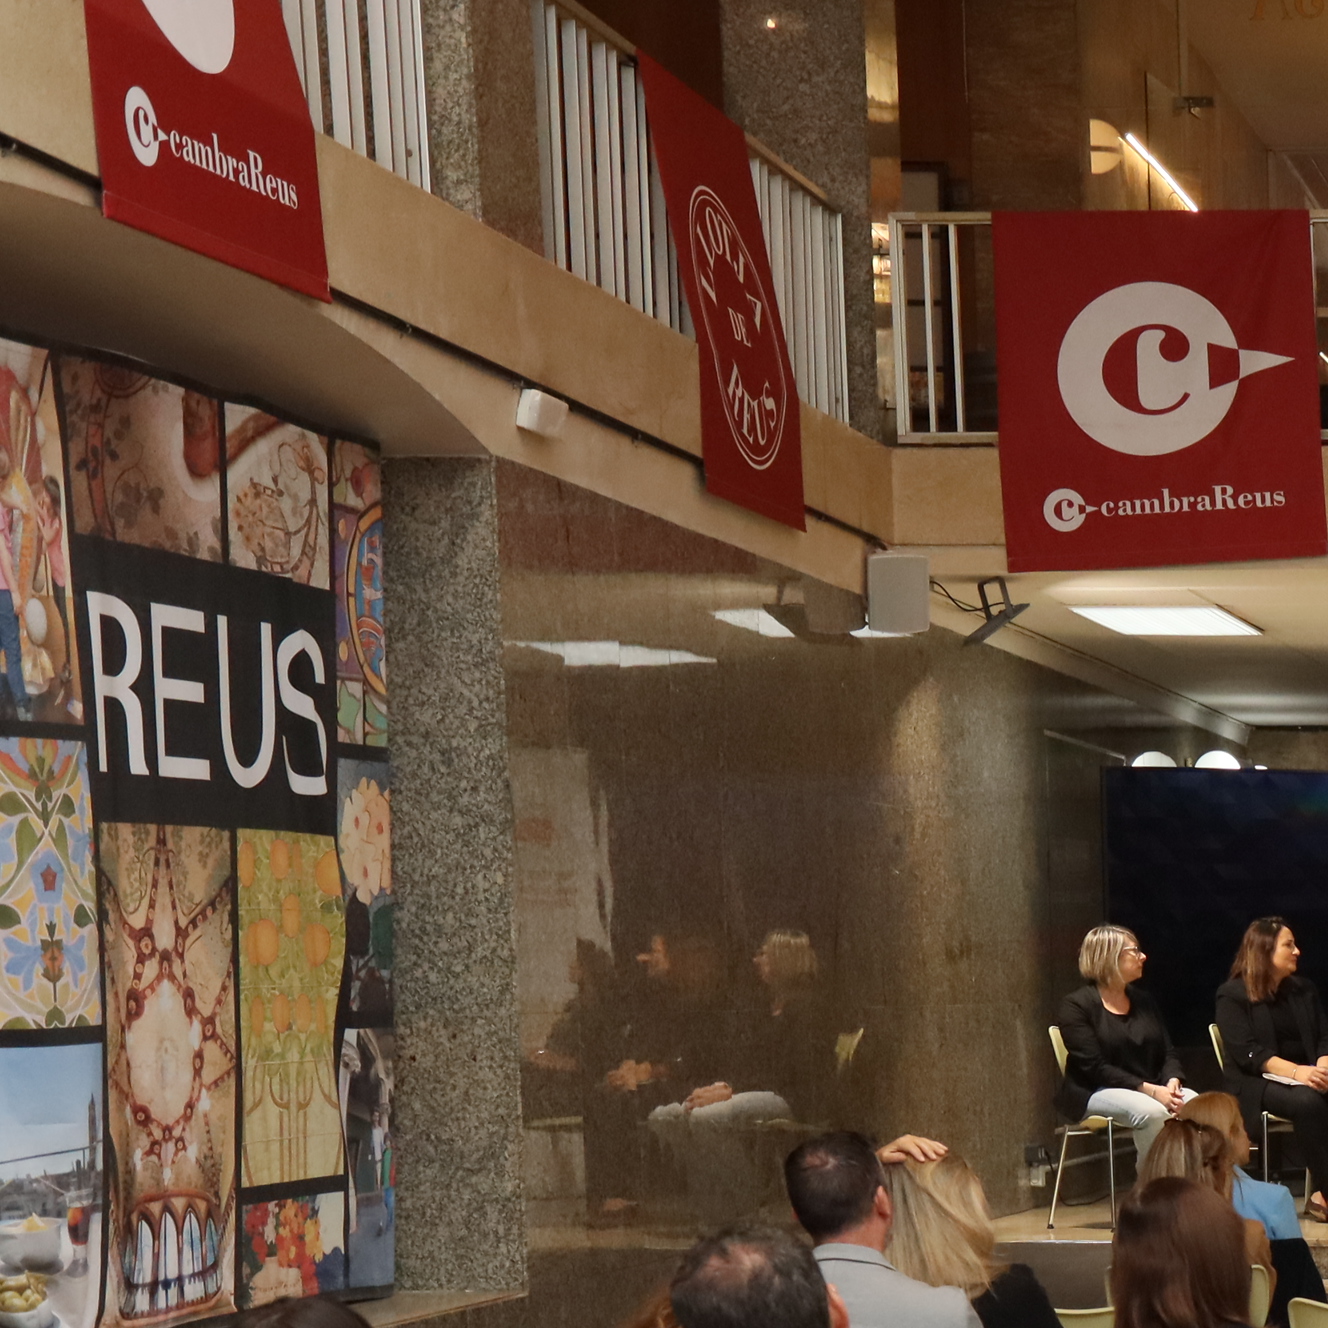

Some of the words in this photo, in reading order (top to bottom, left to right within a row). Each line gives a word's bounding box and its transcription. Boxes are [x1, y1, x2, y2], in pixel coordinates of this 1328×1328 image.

[169, 124, 300, 212] cambraReus
[694, 203, 764, 336] LLOTJA
[728, 305, 751, 349] DE
[727, 359, 777, 451] REUS
[1100, 483, 1287, 519] cambraReus
[85, 589, 329, 796] REUS
